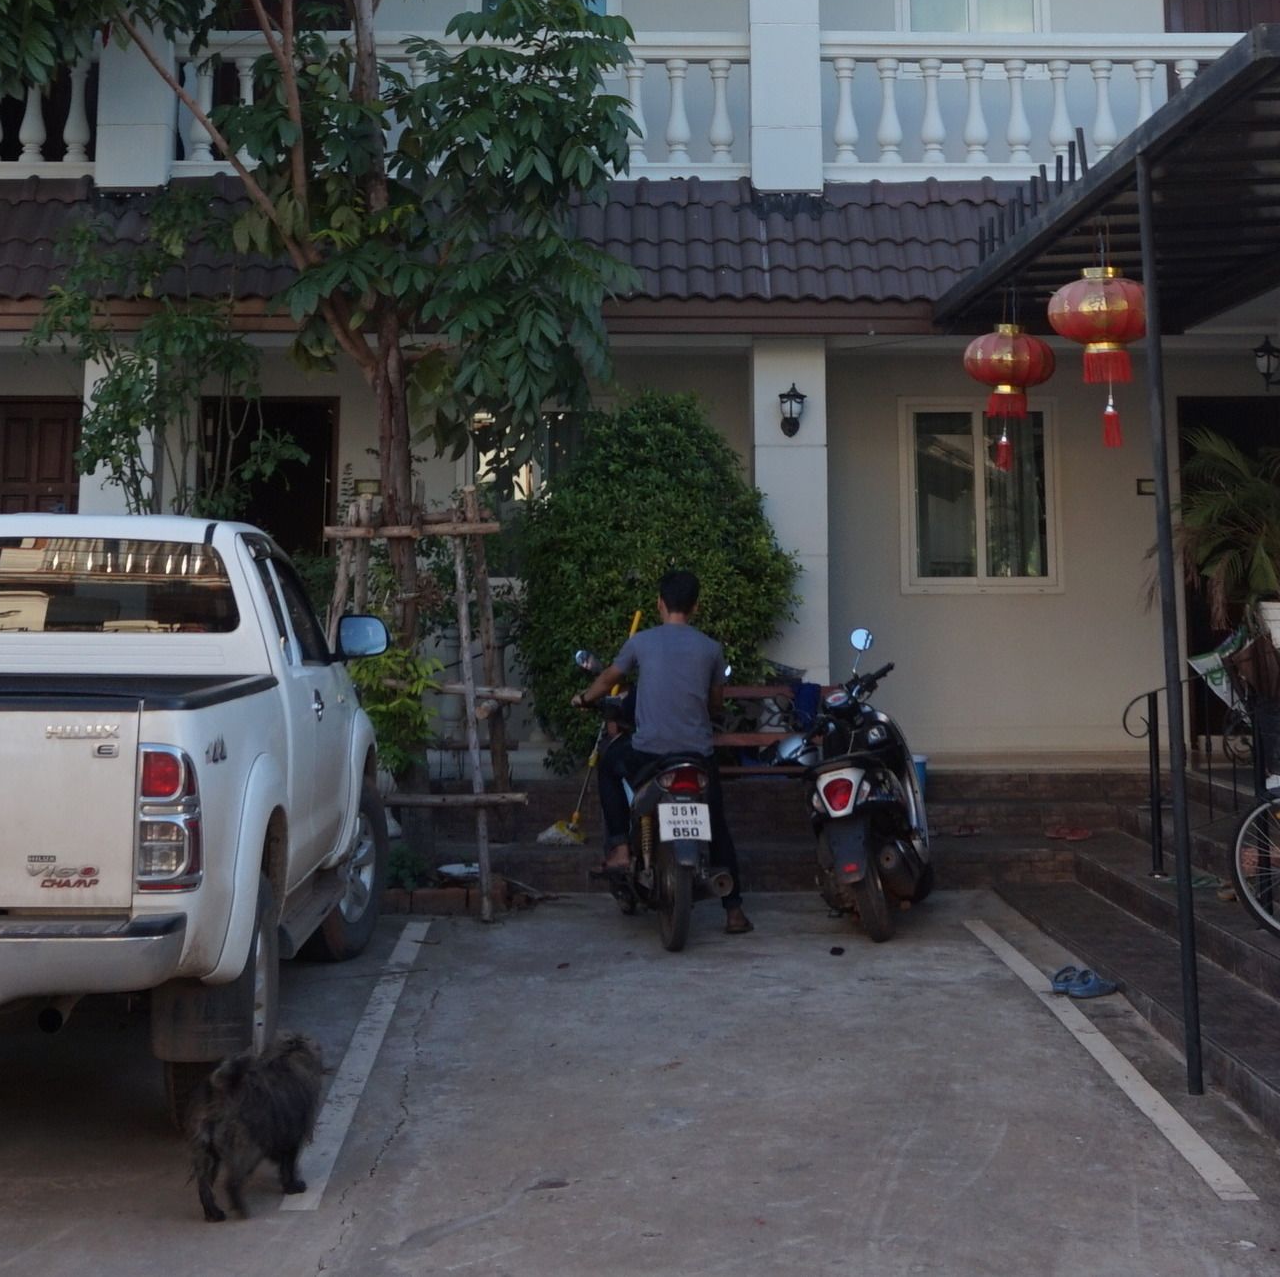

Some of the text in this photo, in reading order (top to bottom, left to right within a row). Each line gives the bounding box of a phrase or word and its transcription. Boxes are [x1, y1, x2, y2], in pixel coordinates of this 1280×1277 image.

[45, 724, 119, 739] HILUX
[96, 744, 115, 756] E
[672, 827, 700, 838] 650
[26, 864, 99, 878] VIGO
[40, 878, 100, 889] CHAMP
